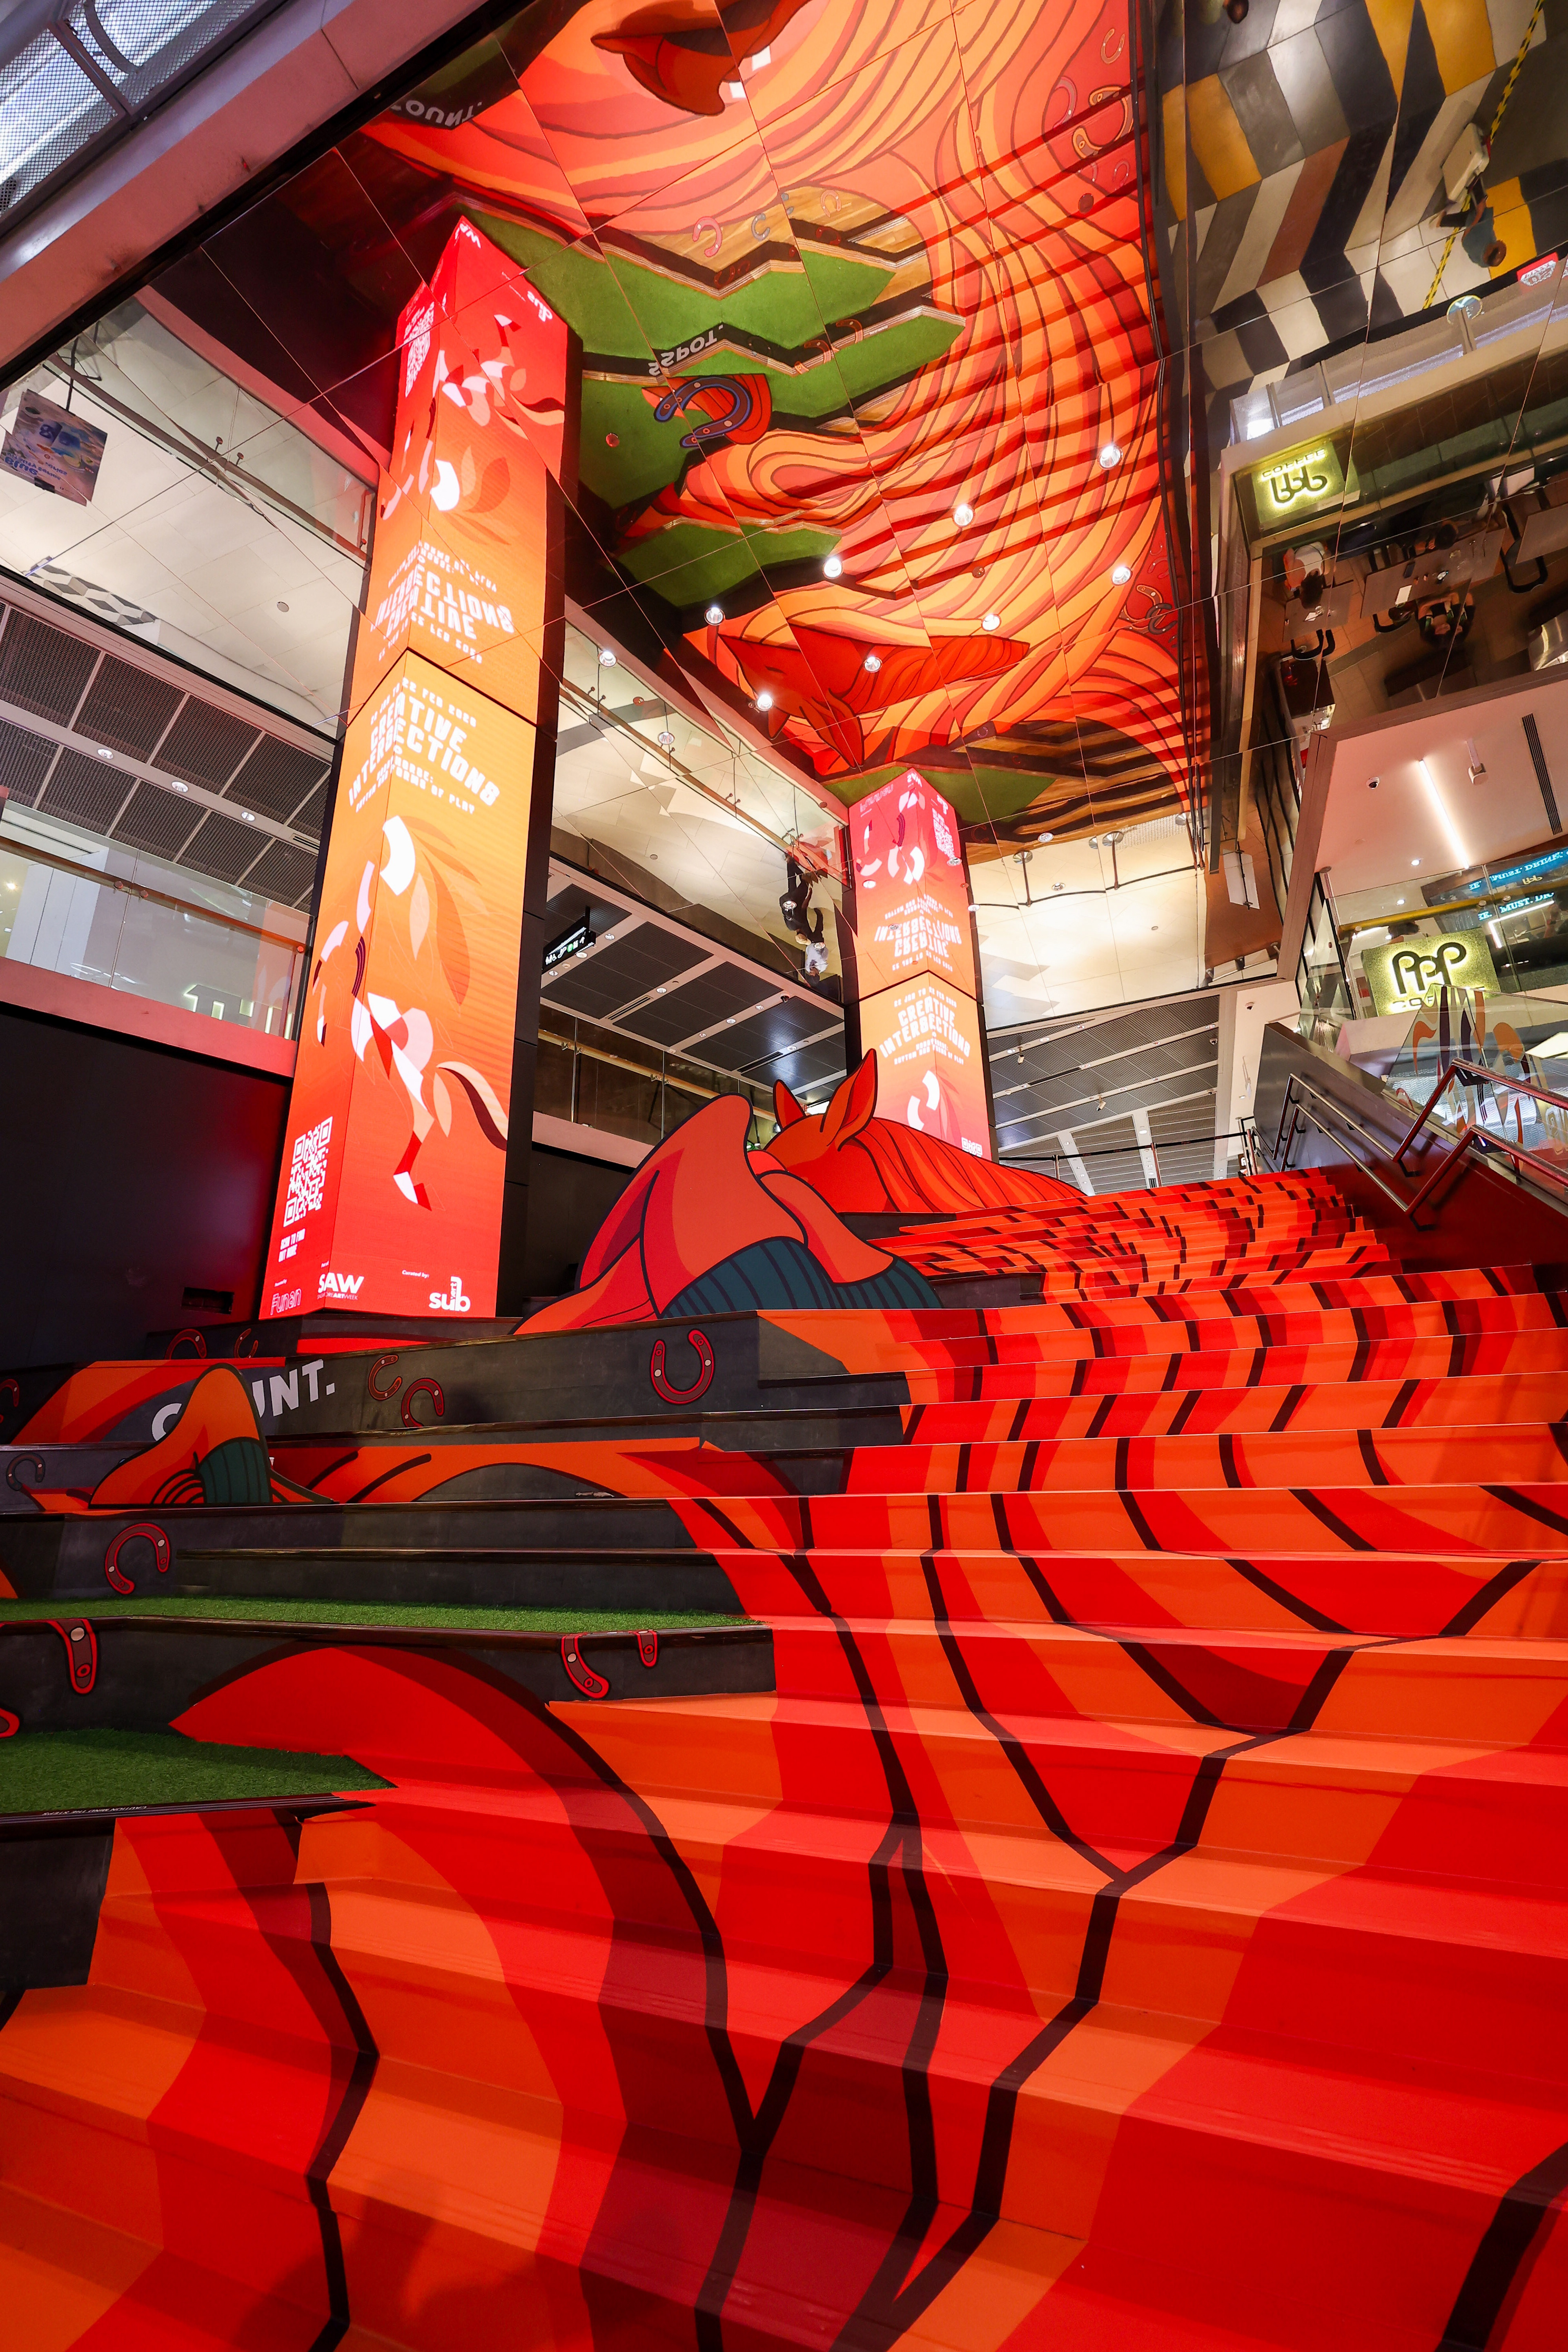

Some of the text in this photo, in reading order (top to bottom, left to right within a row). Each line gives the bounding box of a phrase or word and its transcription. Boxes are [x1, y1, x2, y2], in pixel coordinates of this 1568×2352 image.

[370, 692, 468, 753] CREATIVE
[349, 717, 500, 806] INTERSECTIONS
[449, 793, 475, 815] PLAY
[898, 996, 955, 1027] CREATIVE
[879, 1013, 971, 1058] INTERSECTIONS
[318, 1272, 365, 1294] SAW
[270, 1288, 302, 1316] Funan
